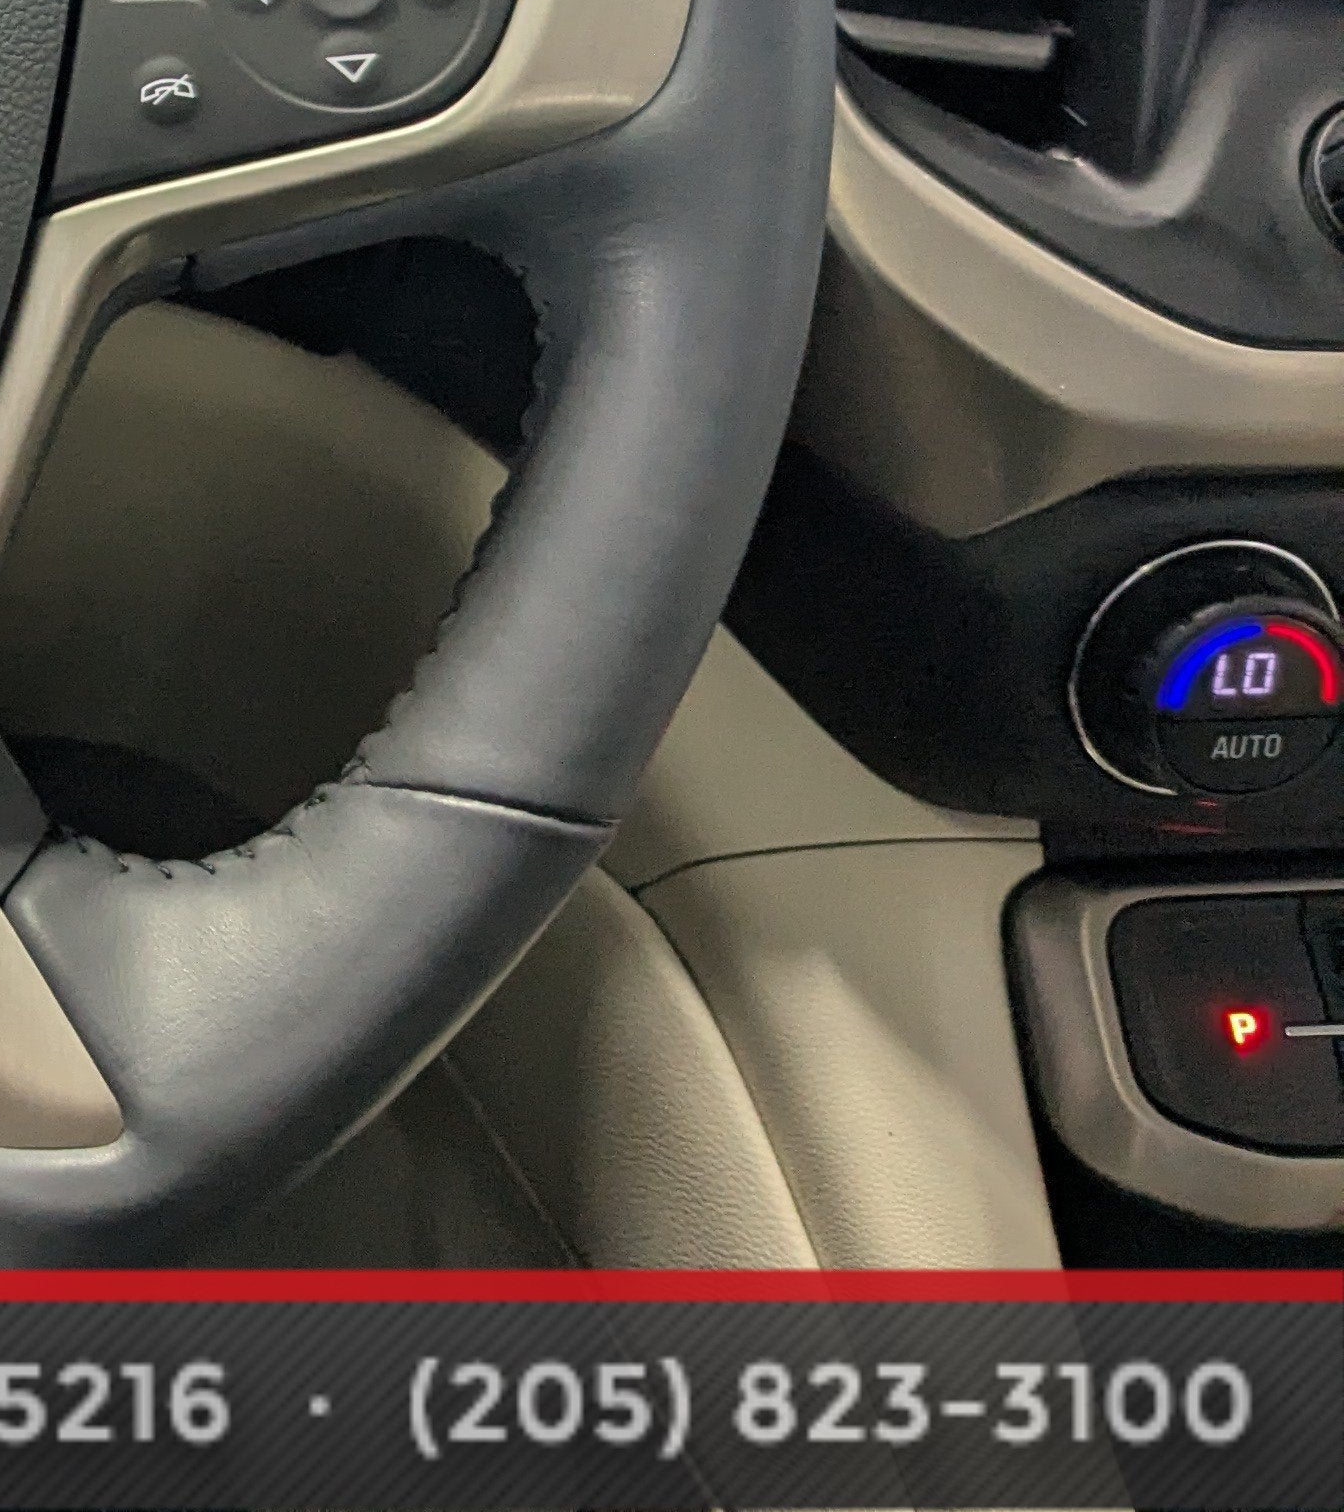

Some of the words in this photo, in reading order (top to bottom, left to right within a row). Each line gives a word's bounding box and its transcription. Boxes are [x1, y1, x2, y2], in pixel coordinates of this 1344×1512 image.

[1212, 652, 1277, 696] LO
[1211, 734, 1283, 760] AUTO
[1228, 1013, 1257, 1044] P
